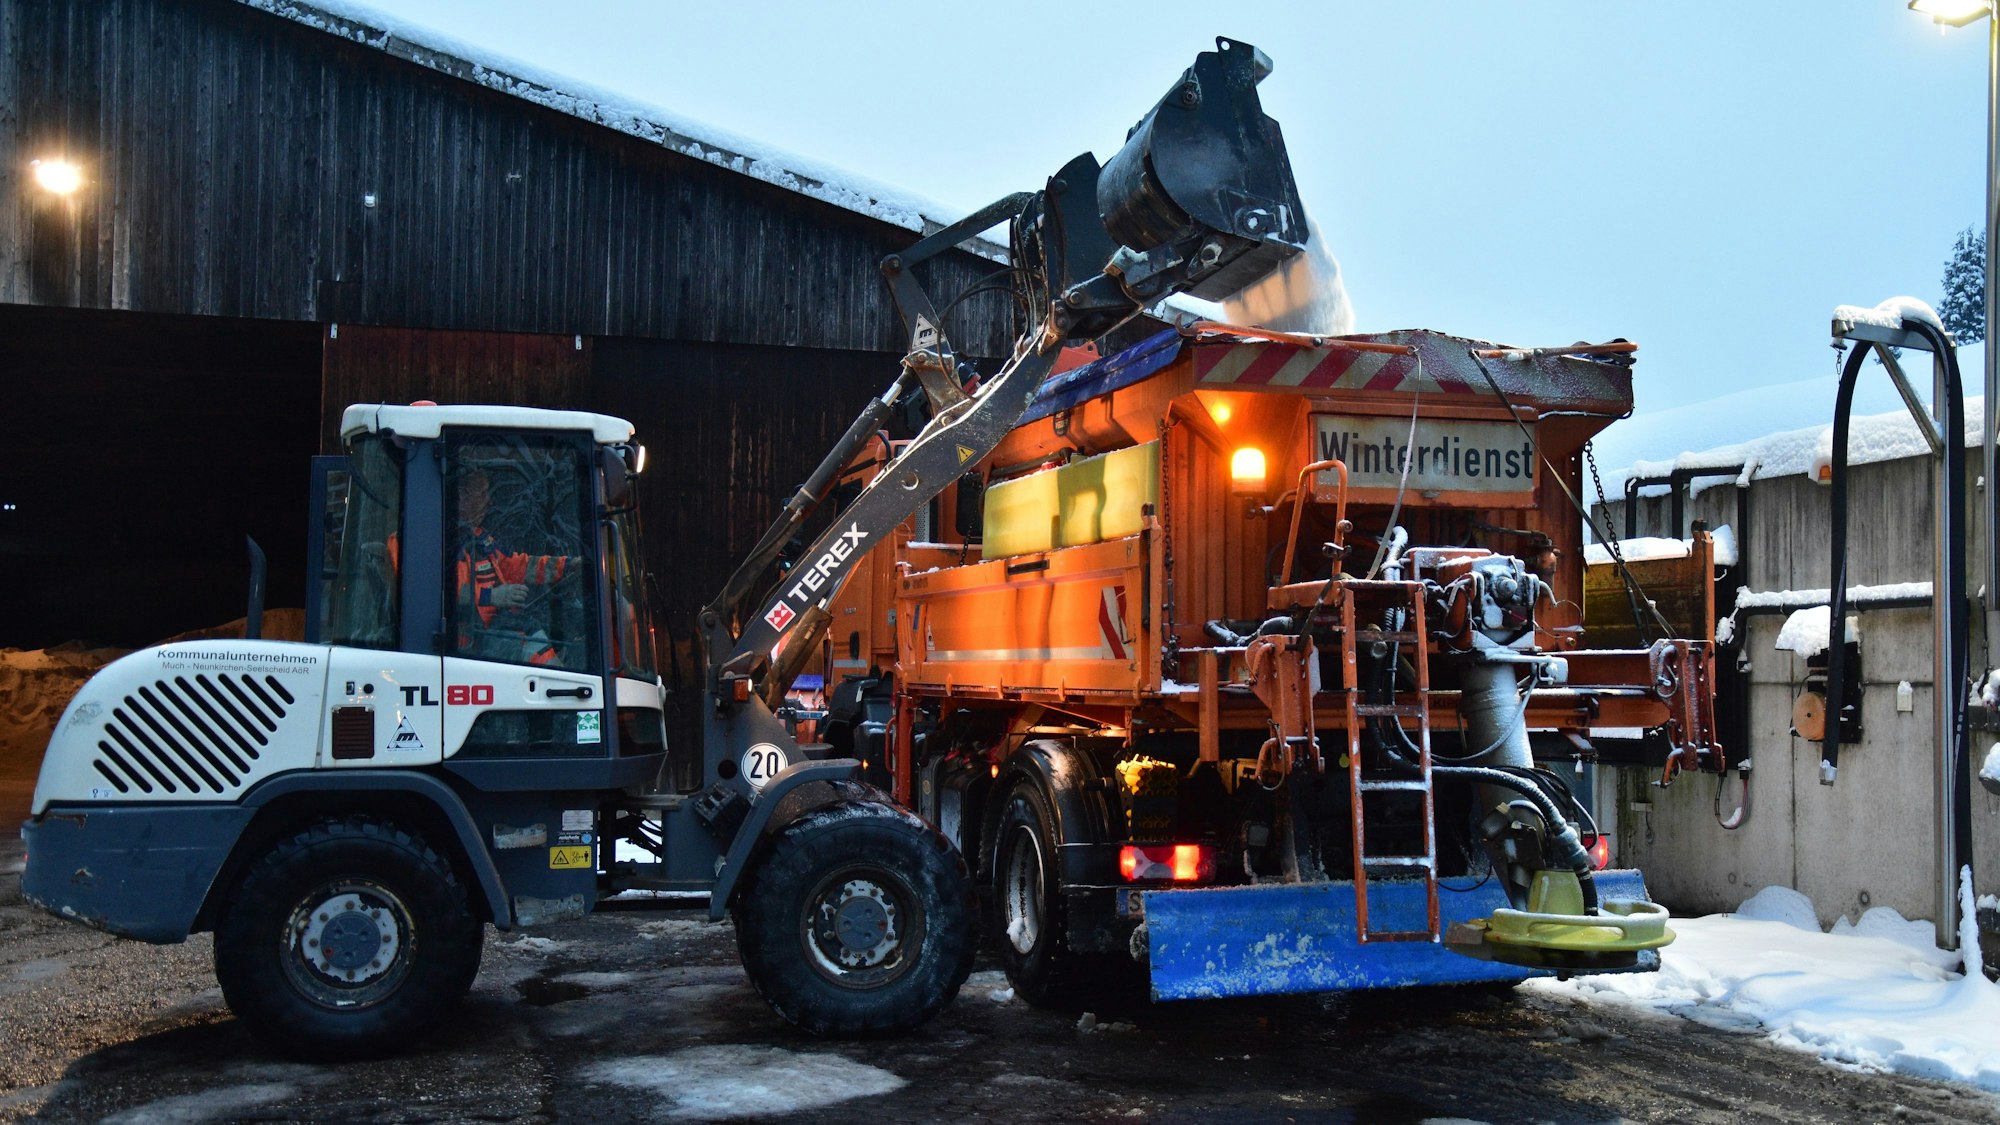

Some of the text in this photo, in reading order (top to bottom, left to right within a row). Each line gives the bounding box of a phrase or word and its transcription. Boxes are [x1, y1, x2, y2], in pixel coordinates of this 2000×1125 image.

[1320, 431, 1533, 479] Winterdienst
[787, 521, 869, 602] TEREX
[157, 649, 317, 664] Kommunalunternehmen
[162, 661, 185, 670] Much
[192, 663, 290, 674] Neunkirchen-Seelscheid
[400, 685, 494, 706] TL 80
[750, 751, 779, 779] 20
